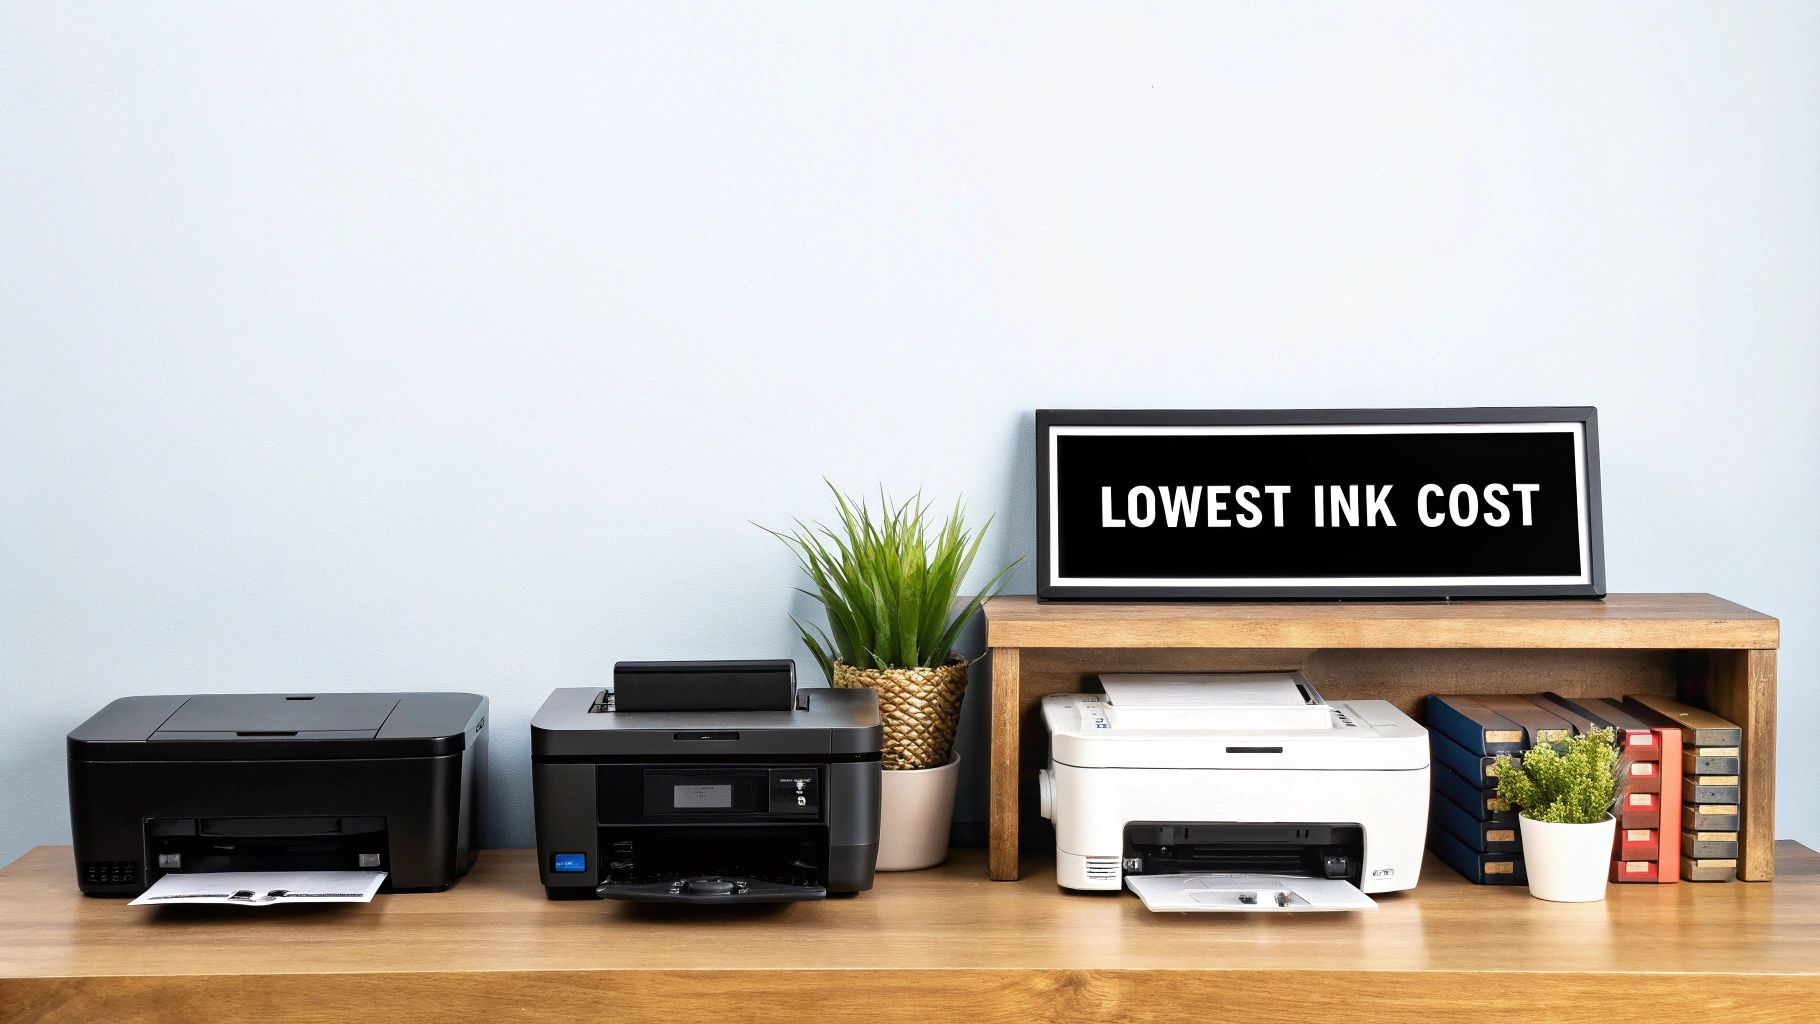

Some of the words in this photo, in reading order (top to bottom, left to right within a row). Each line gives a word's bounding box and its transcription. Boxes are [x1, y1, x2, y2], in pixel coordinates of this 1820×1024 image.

[1101, 485, 1291, 528] LOWEST
[1314, 484, 1397, 527] INK
[1417, 482, 1540, 527] COST
